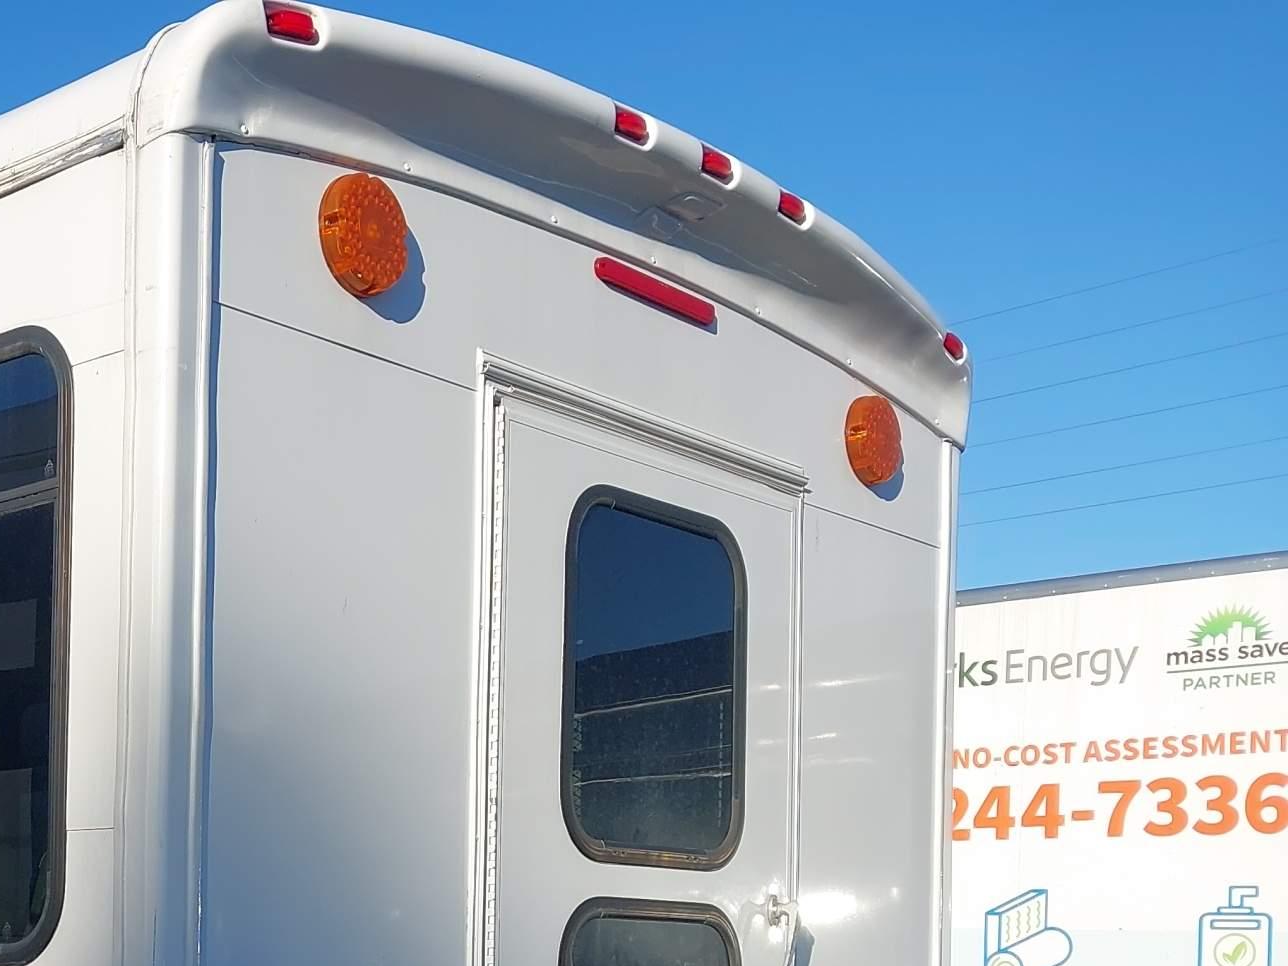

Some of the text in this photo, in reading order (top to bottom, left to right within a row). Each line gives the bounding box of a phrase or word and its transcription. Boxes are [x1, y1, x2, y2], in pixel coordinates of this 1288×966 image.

[954, 645, 1140, 688] ksEnergy
[1166, 641, 1288, 666] mass save
[1183, 671, 1276, 691] PARTNER
[952, 729, 1288, 769] NO-COST ASSESSMENT
[951, 772, 1288, 841] 244-7336
